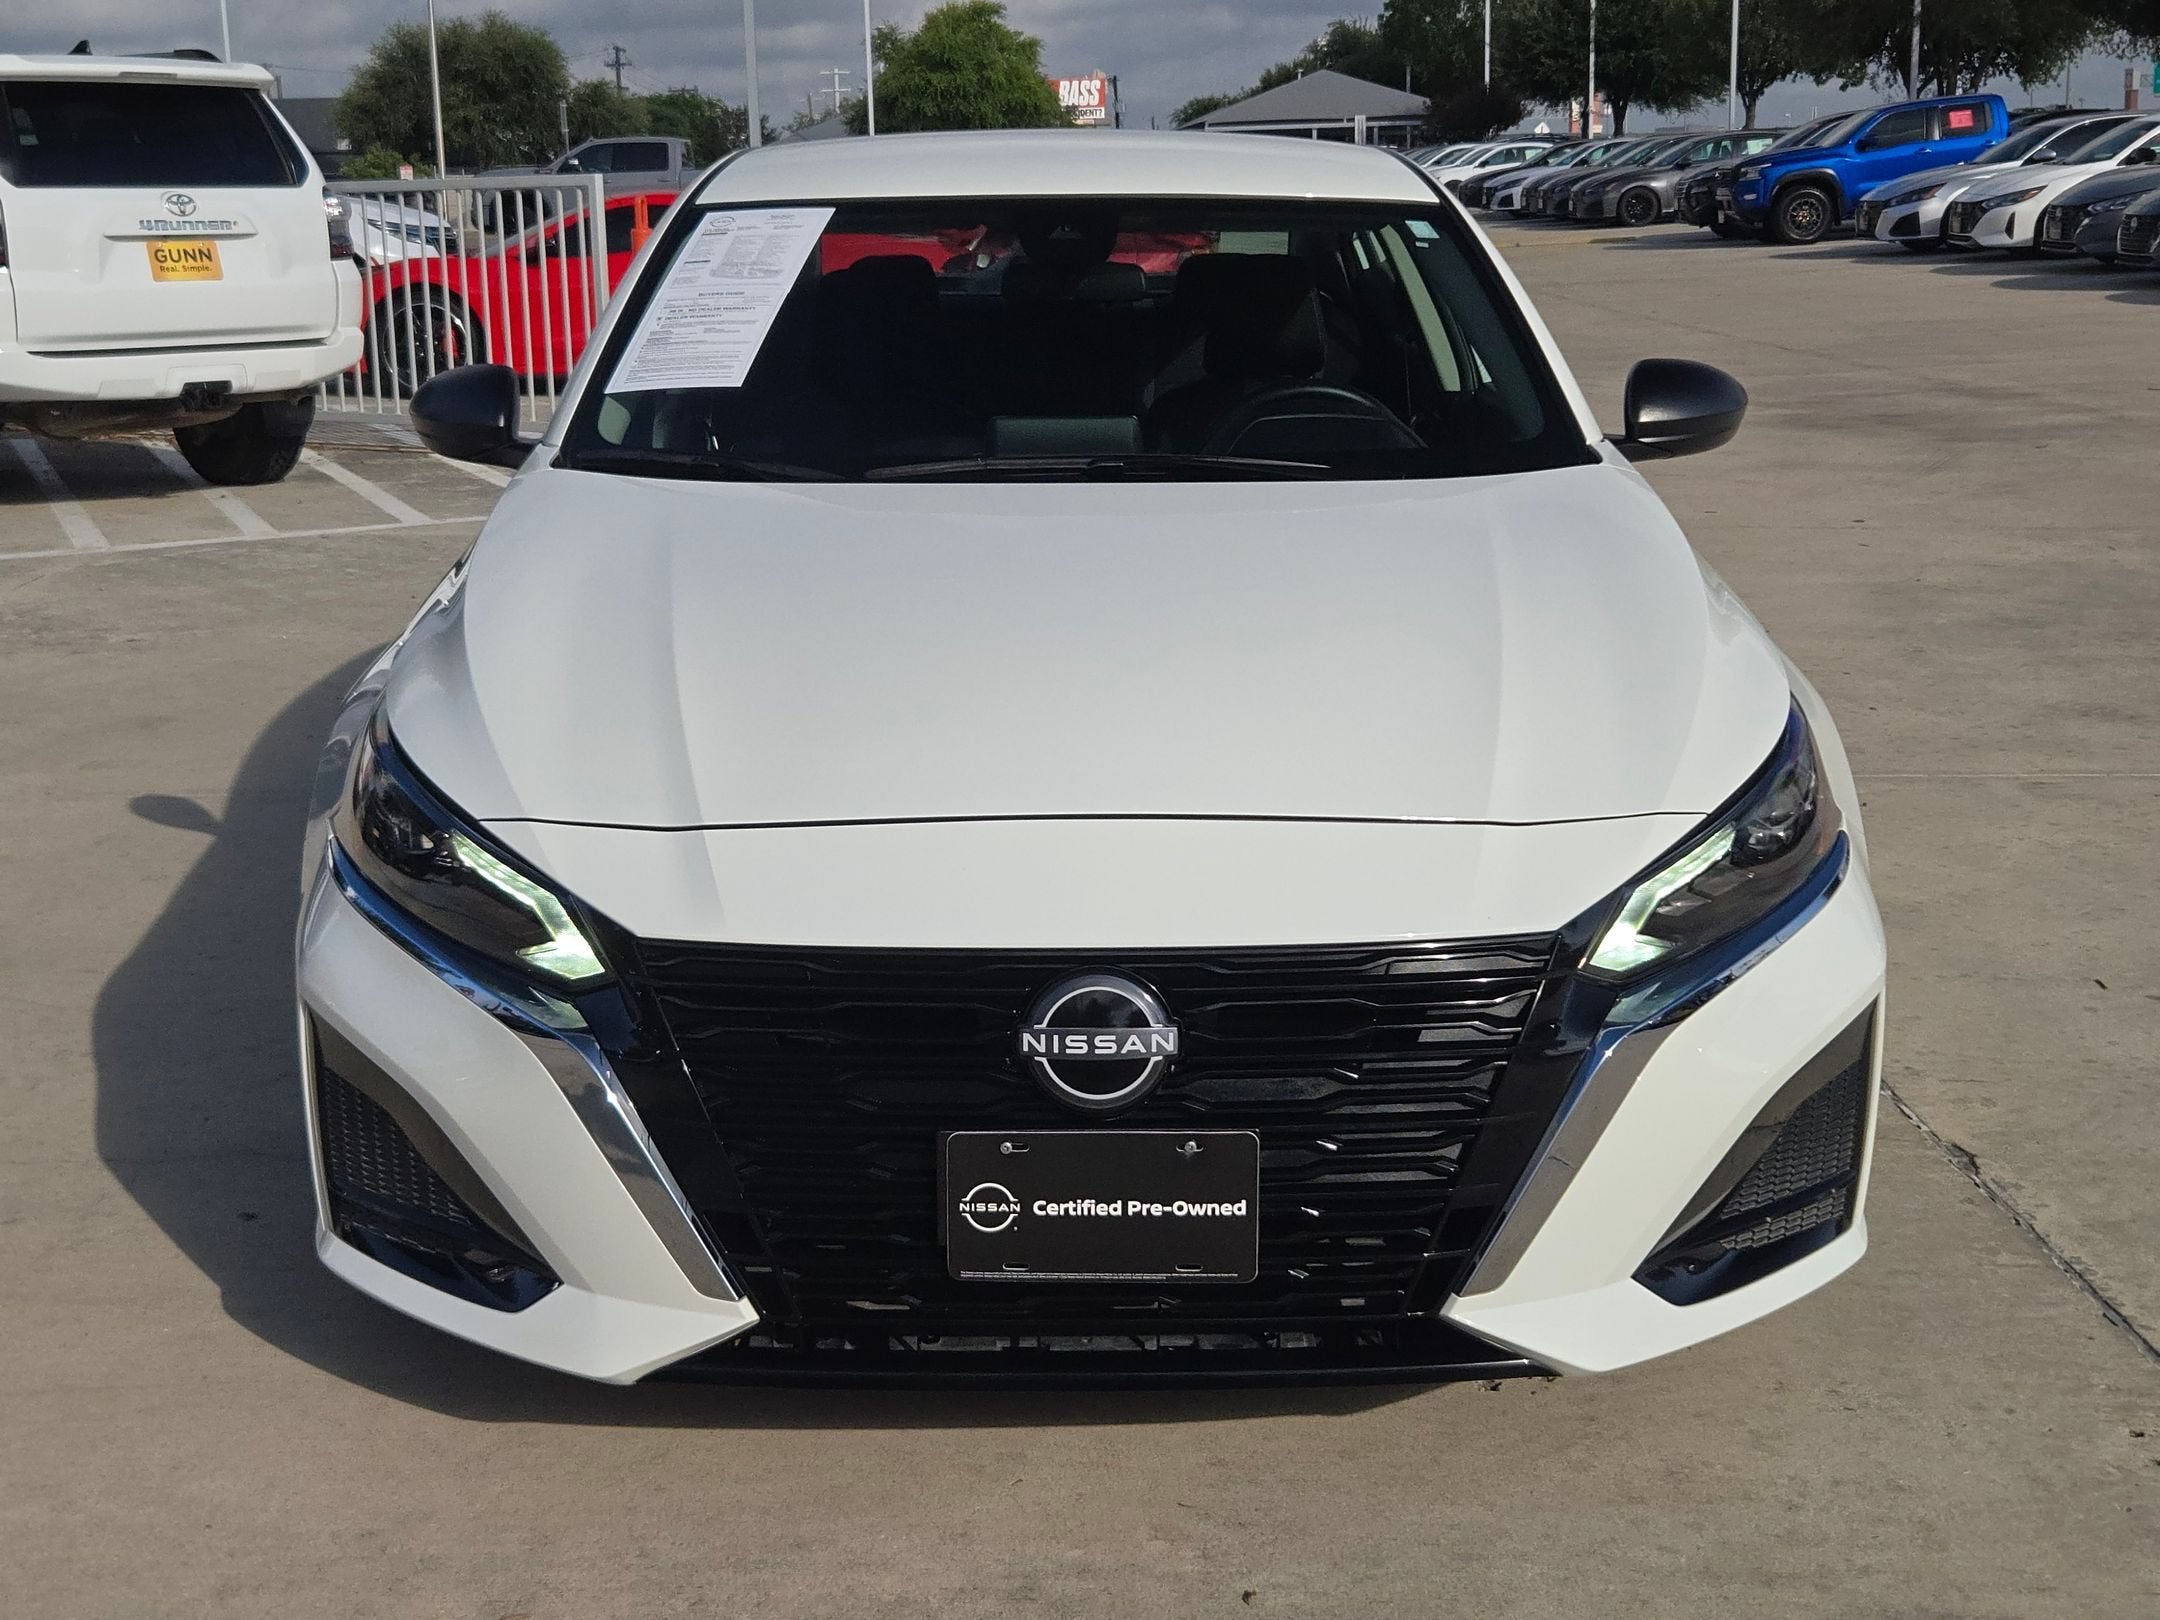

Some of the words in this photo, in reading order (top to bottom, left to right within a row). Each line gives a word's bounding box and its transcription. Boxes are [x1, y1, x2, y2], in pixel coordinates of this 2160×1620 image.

[1059, 80, 1100, 106] BASS
[154, 248, 213, 263] GUNN
[182, 264, 213, 273] Simple.
[1022, 1032, 1174, 1054] NISSAN
[960, 1202, 1020, 1212] NISSAN
[1032, 1200, 1122, 1216] Certified
[1127, 1200, 1247, 1216] Pre-Owned
